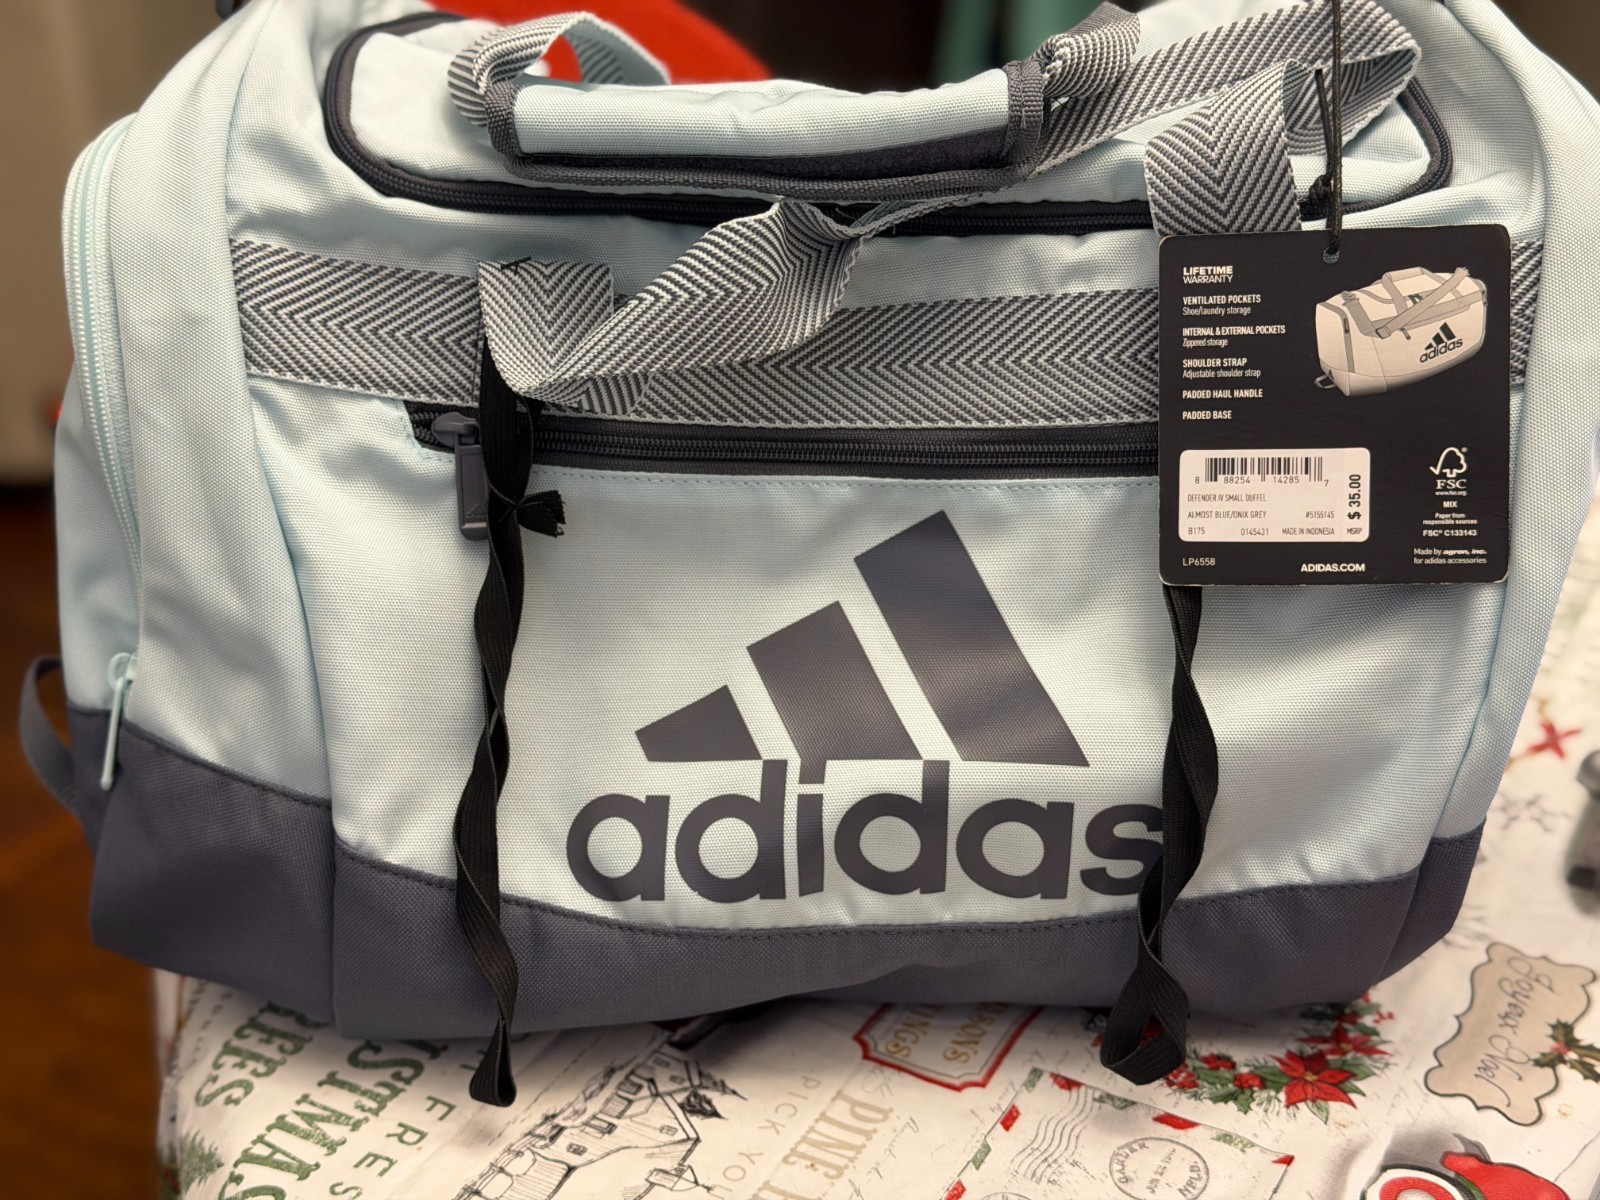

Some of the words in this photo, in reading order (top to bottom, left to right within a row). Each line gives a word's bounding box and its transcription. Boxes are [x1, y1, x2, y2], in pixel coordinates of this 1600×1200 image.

[1183, 265, 1233, 276] LIFETIME
[1183, 275, 1234, 284] WARRANTY
[1183, 296, 1226, 305] VENTILATED
[1228, 294, 1261, 304] POCKETS
[1183, 306, 1225, 316] Shoe/laundry
[1227, 306, 1251, 316] storage
[1183, 327, 1214, 336] INTERNAL
[1215, 327, 1221, 336] &
[1221, 326, 1255, 335] EXTERNAL
[1255, 325, 1286, 334] POCKETS
[1183, 338, 1206, 348] Zippered
[1207, 338, 1228, 348] storage
[1419, 338, 1463, 363] adidas
[1183, 358, 1221, 368] SHOULDER
[1223, 357, 1247, 367] STRAP
[1183, 369, 1215, 380] Adjustable
[1217, 369, 1243, 378] shoulder
[1245, 368, 1261, 379] strap
[1183, 389, 1211, 399] PADDED
[1213, 389, 1232, 398] HAUL
[1234, 389, 1263, 398] HANDLE
[1183, 411, 1211, 420] PADDED
[1213, 410, 1232, 419] BASE
[1194, 476, 1200, 484] 8
[1224, 476, 1251, 484] 88254
[1273, 475, 1300, 484] 14285
[1435, 479, 1467, 489] FSC
[1348, 474, 1361, 508] 35.00
[1187, 493, 1216, 502] DEFENDER
[1218, 494, 1224, 502] IV
[1225, 494, 1244, 502] SMALL
[1245, 494, 1267, 502] DUFFEL
[1187, 511, 1213, 519] ALMOST
[1215, 510, 1249, 519] BLUE/ONIX
[1250, 510, 1267, 519] GREY
[1347, 511, 1362, 520] $
[1305, 527, 1335, 535] INDONESIA
[1444, 529, 1478, 537] C133143
[1434, 548, 1442, 556] by
[1182, 557, 1216, 567] LP6558
[1300, 563, 1366, 573] ADIDAS.COM
[566, 759, 1163, 903] adidas
[758, 1075, 822, 1136] PICK
[782, 1089, 894, 1180] PINE
